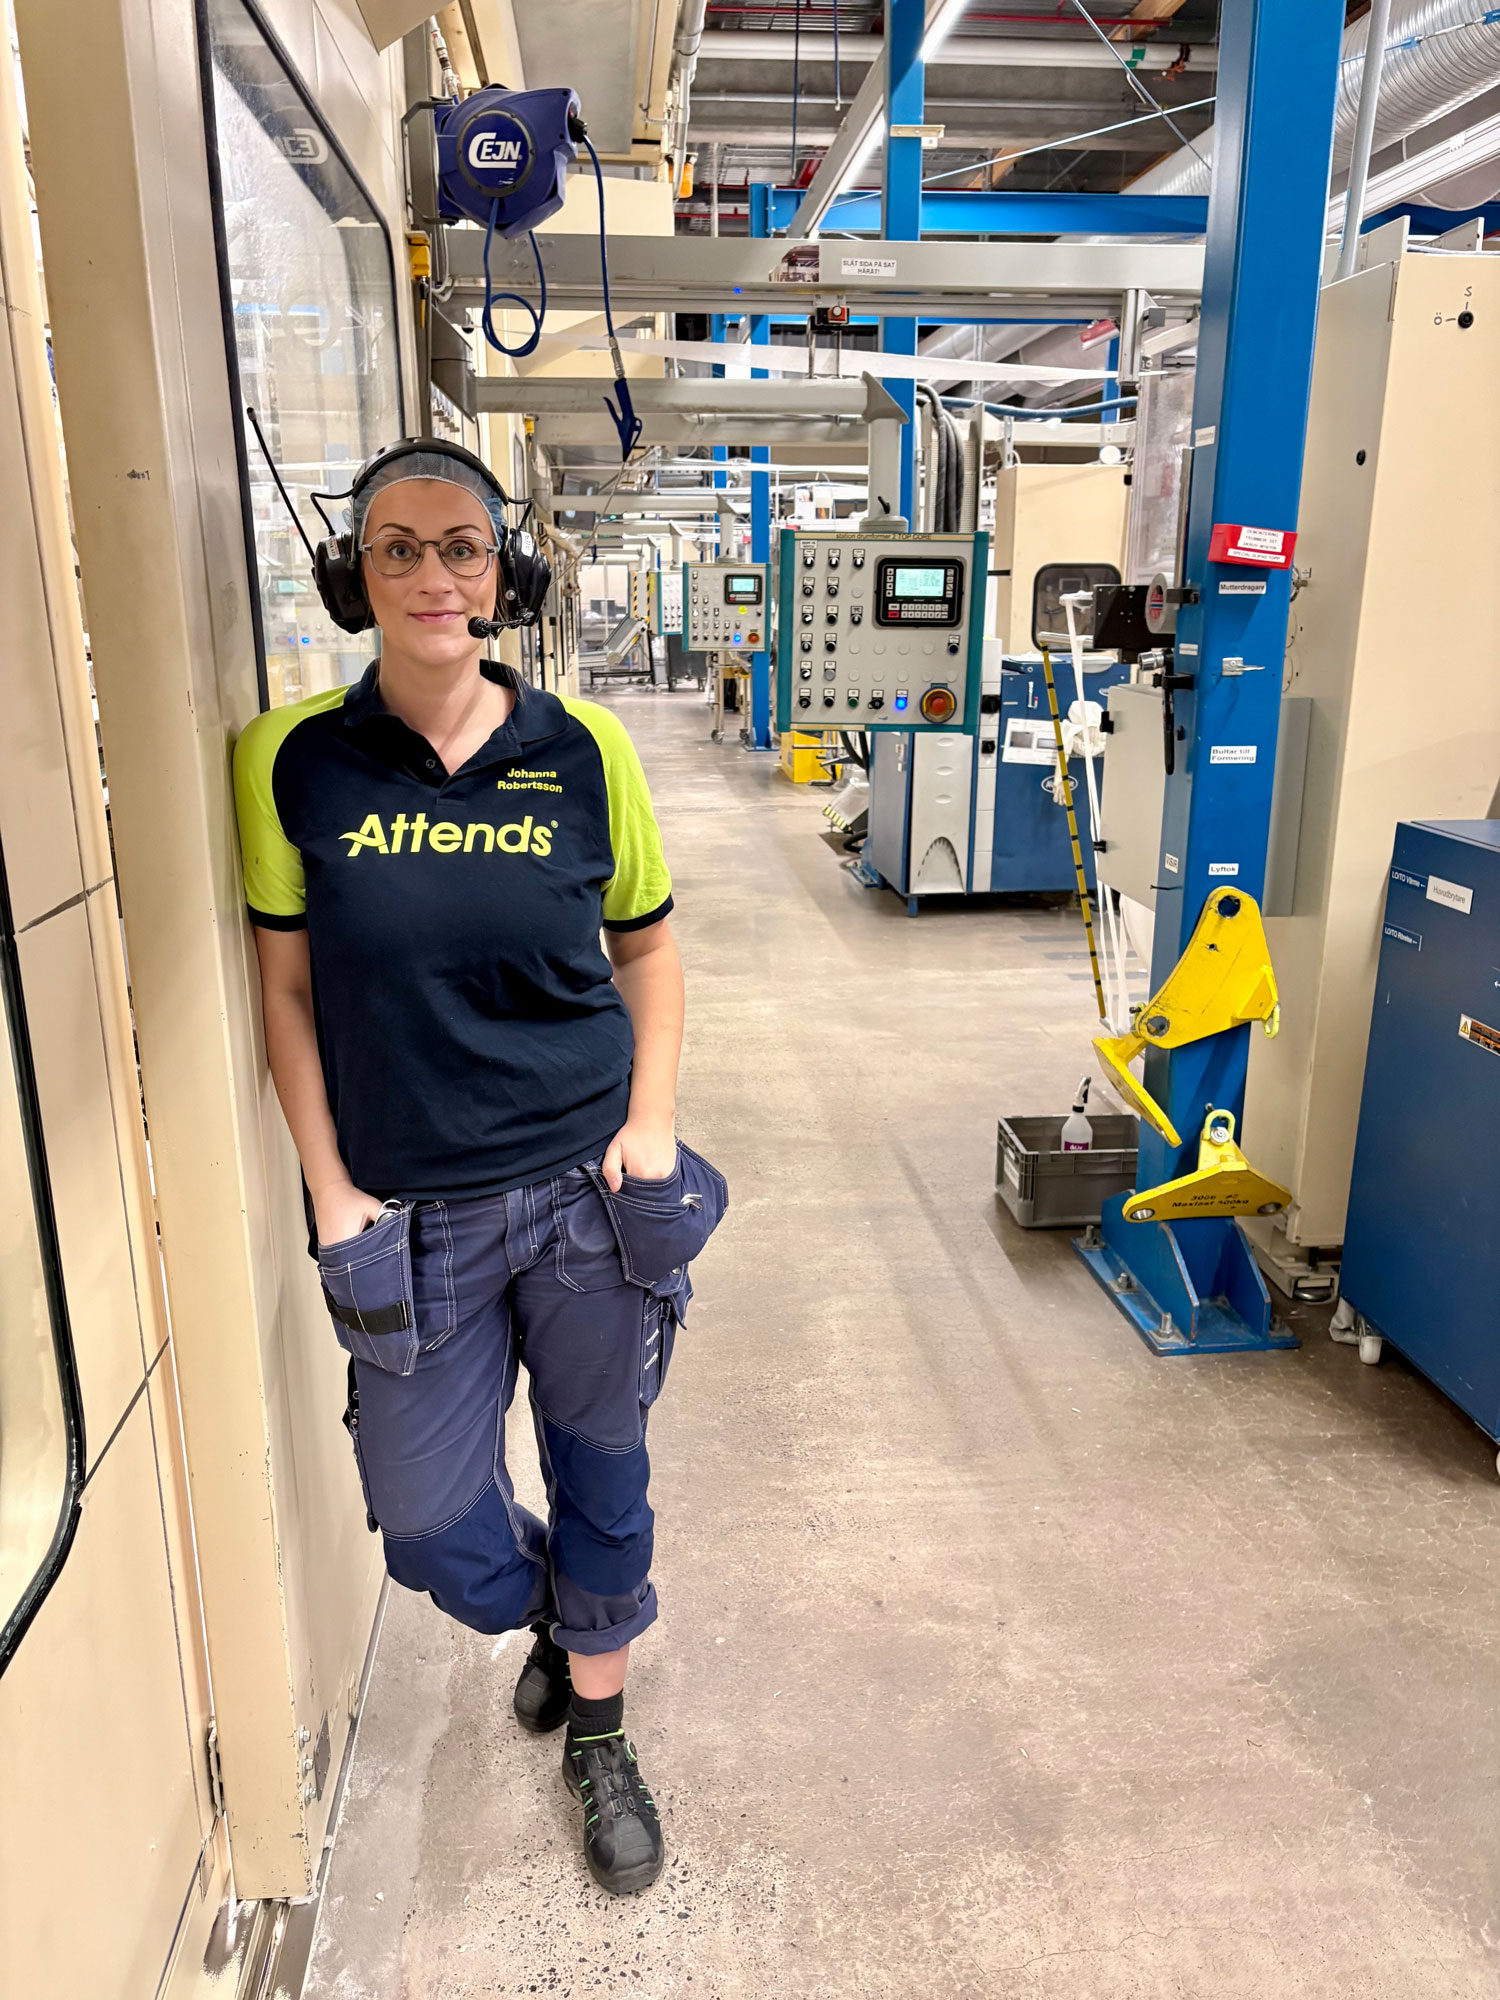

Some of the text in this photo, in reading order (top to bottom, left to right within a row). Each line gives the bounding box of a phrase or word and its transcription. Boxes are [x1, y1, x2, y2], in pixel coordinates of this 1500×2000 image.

[468, 132, 521, 168] CEJN
[1464, 286, 1472, 297] S
[507, 768, 557, 778] Johanna
[497, 780, 563, 793] Robertsson
[1433, 885, 1466, 904] Huvudbrytare
